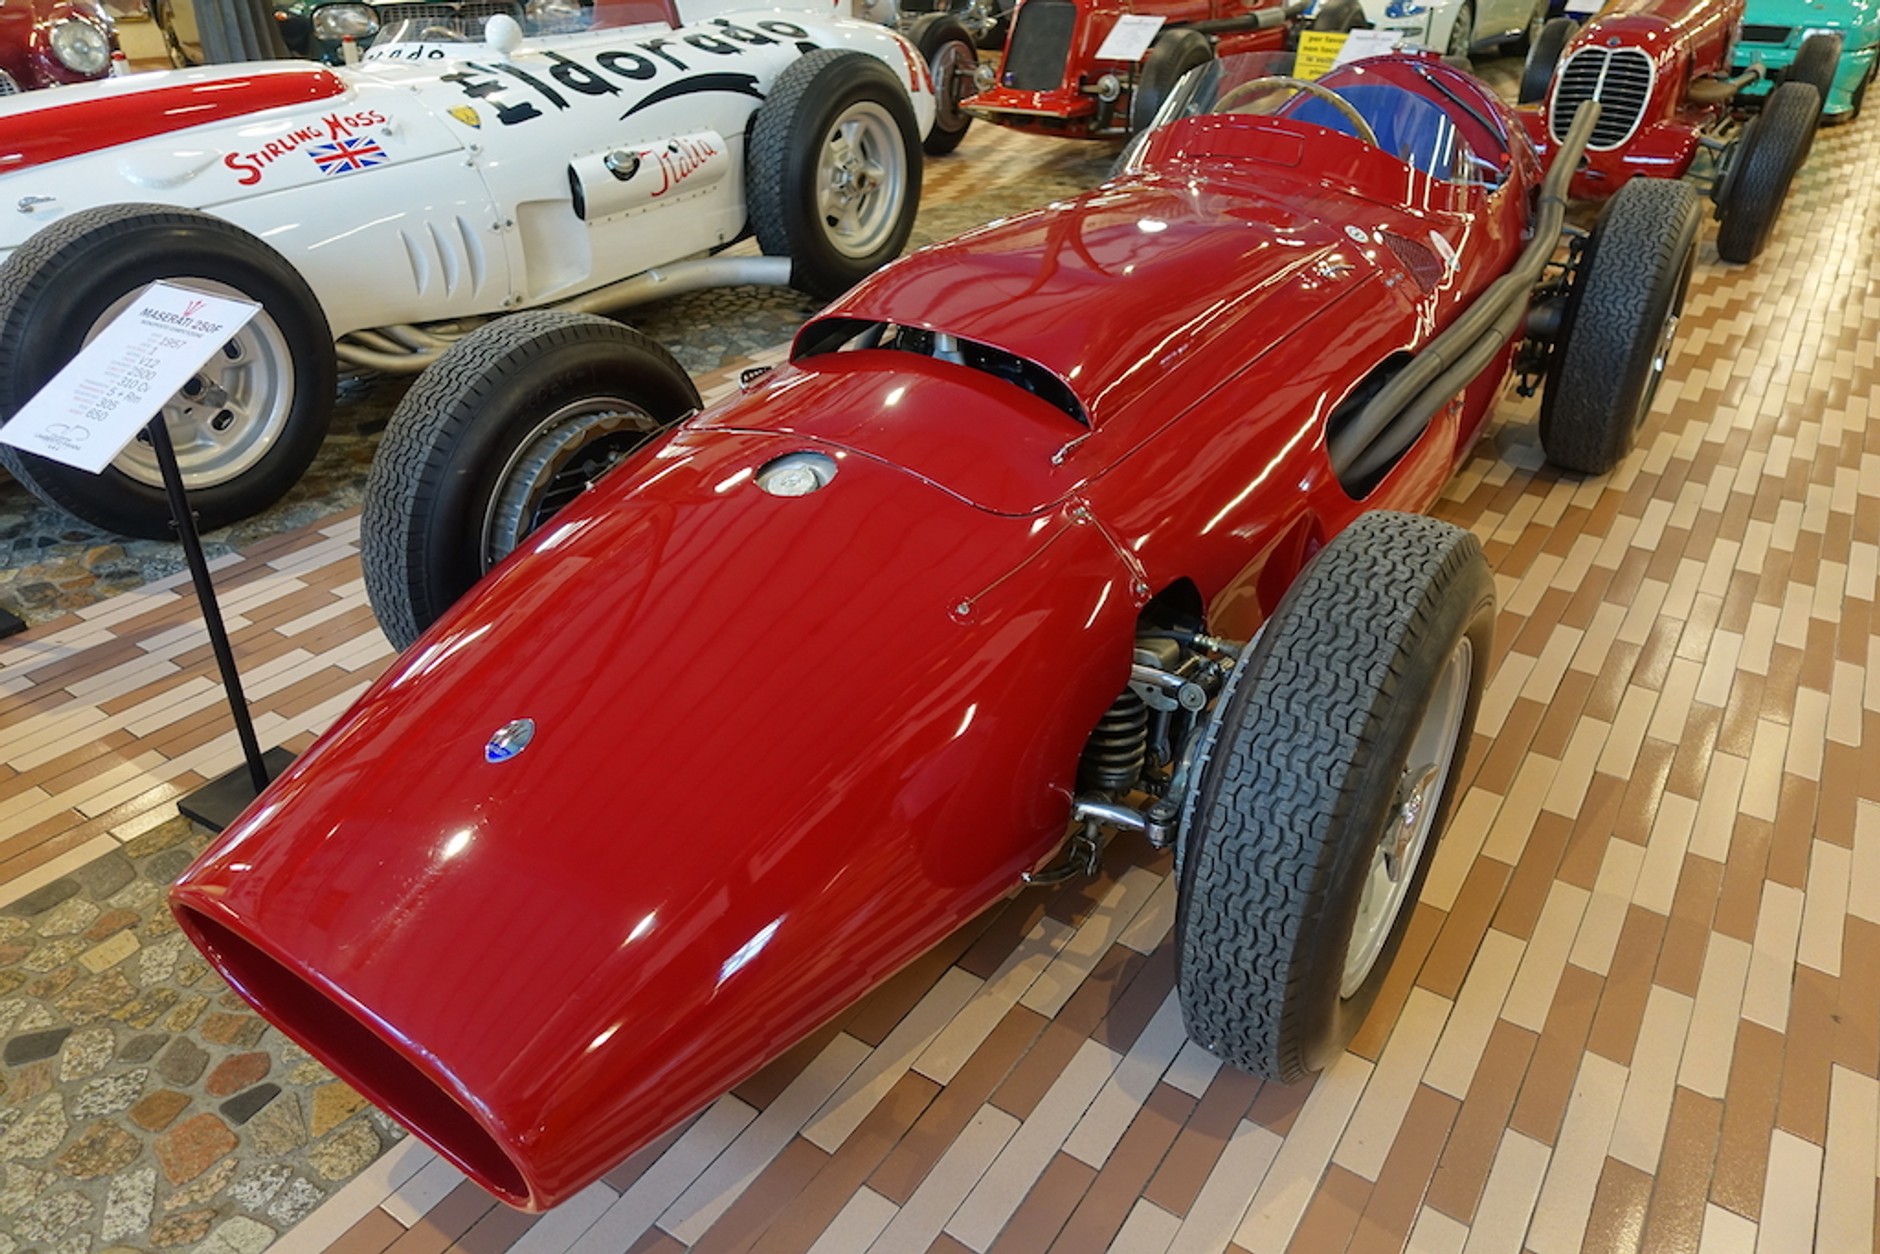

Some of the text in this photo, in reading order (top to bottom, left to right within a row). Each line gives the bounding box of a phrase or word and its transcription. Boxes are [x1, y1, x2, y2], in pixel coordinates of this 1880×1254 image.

[1324, 35, 1347, 43] favor
[441, 18, 811, 126] Eldorado
[224, 109, 386, 186] STIRLING MOSS
[139, 307, 223, 334] MASERATI 250F
[116, 376, 140, 389] 310
[127, 366, 157, 382] 2500
